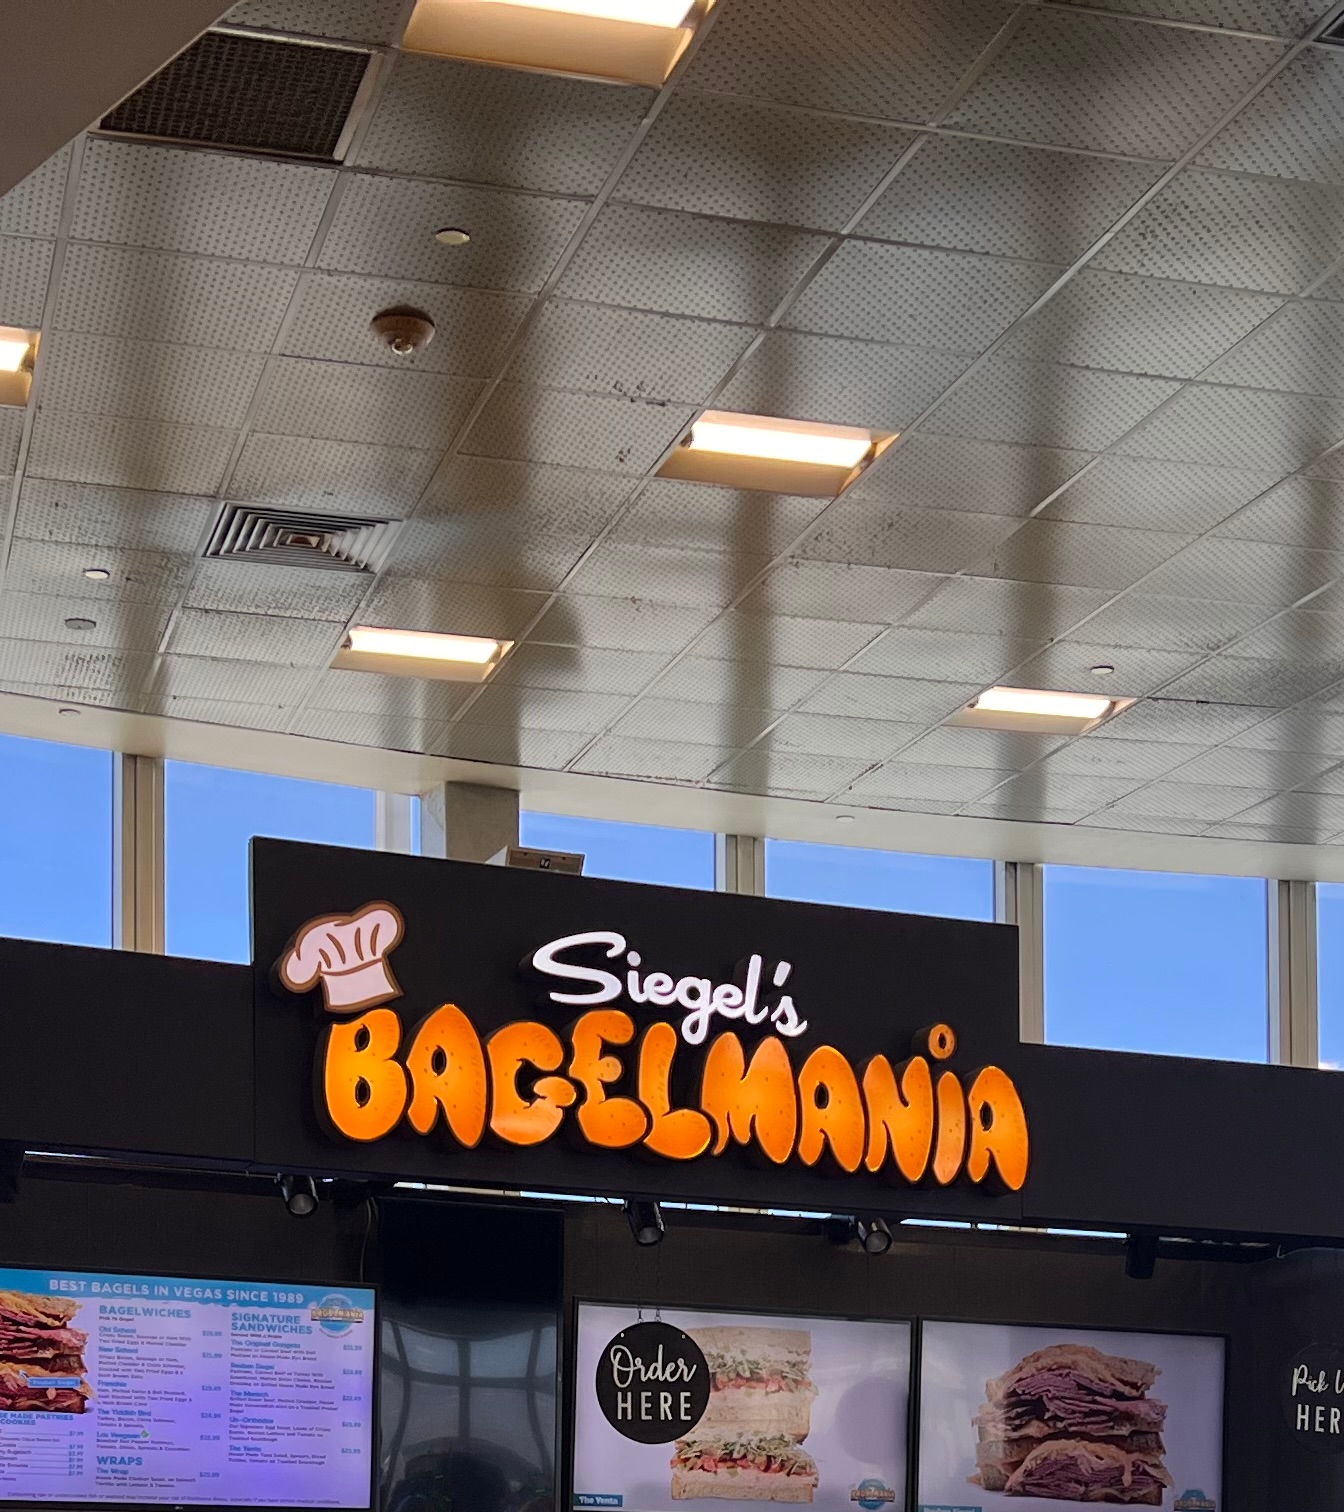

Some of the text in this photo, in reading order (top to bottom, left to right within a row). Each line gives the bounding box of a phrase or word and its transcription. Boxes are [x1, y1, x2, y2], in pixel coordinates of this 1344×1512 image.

[533, 931, 807, 1045] Siegel's
[324, 1004, 1029, 1191] BAGELMANIA
[50, 1279, 304, 1303] BEST BAGELS IN VEGAS SINCE 1989
[99, 1305, 191, 1318] BAGELWICHES
[232, 1313, 300, 1324] SIGNATURE
[231, 1322, 312, 1334] SANDWICHES
[610, 1344, 696, 1388] Order
[1292, 1364, 1329, 1396] Pick
[617, 1392, 692, 1420] HERE
[96, 1456, 142, 1466] WRAPS
